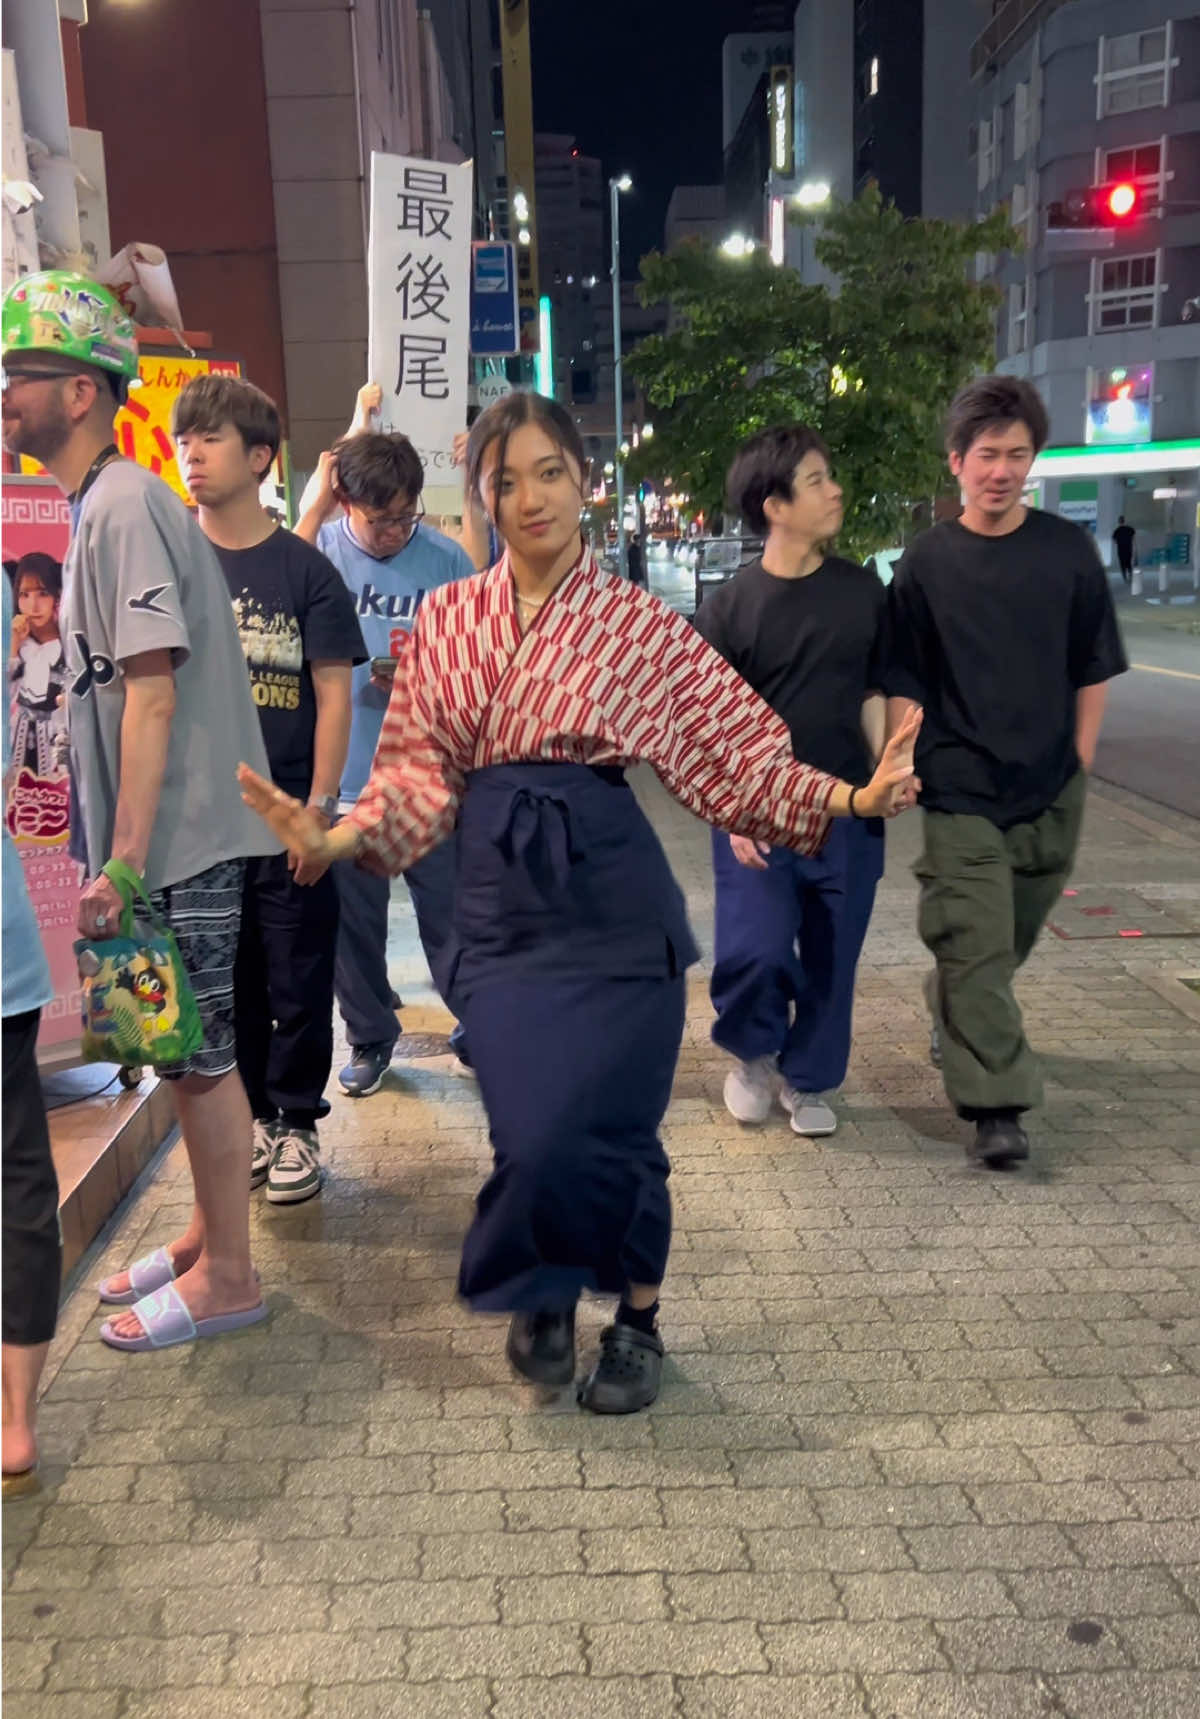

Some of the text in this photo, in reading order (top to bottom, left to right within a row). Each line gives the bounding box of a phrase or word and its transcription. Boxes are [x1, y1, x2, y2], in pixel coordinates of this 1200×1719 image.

[395, 167, 453, 399] 最後尾
[259, 671, 300, 687] LEAGUE
